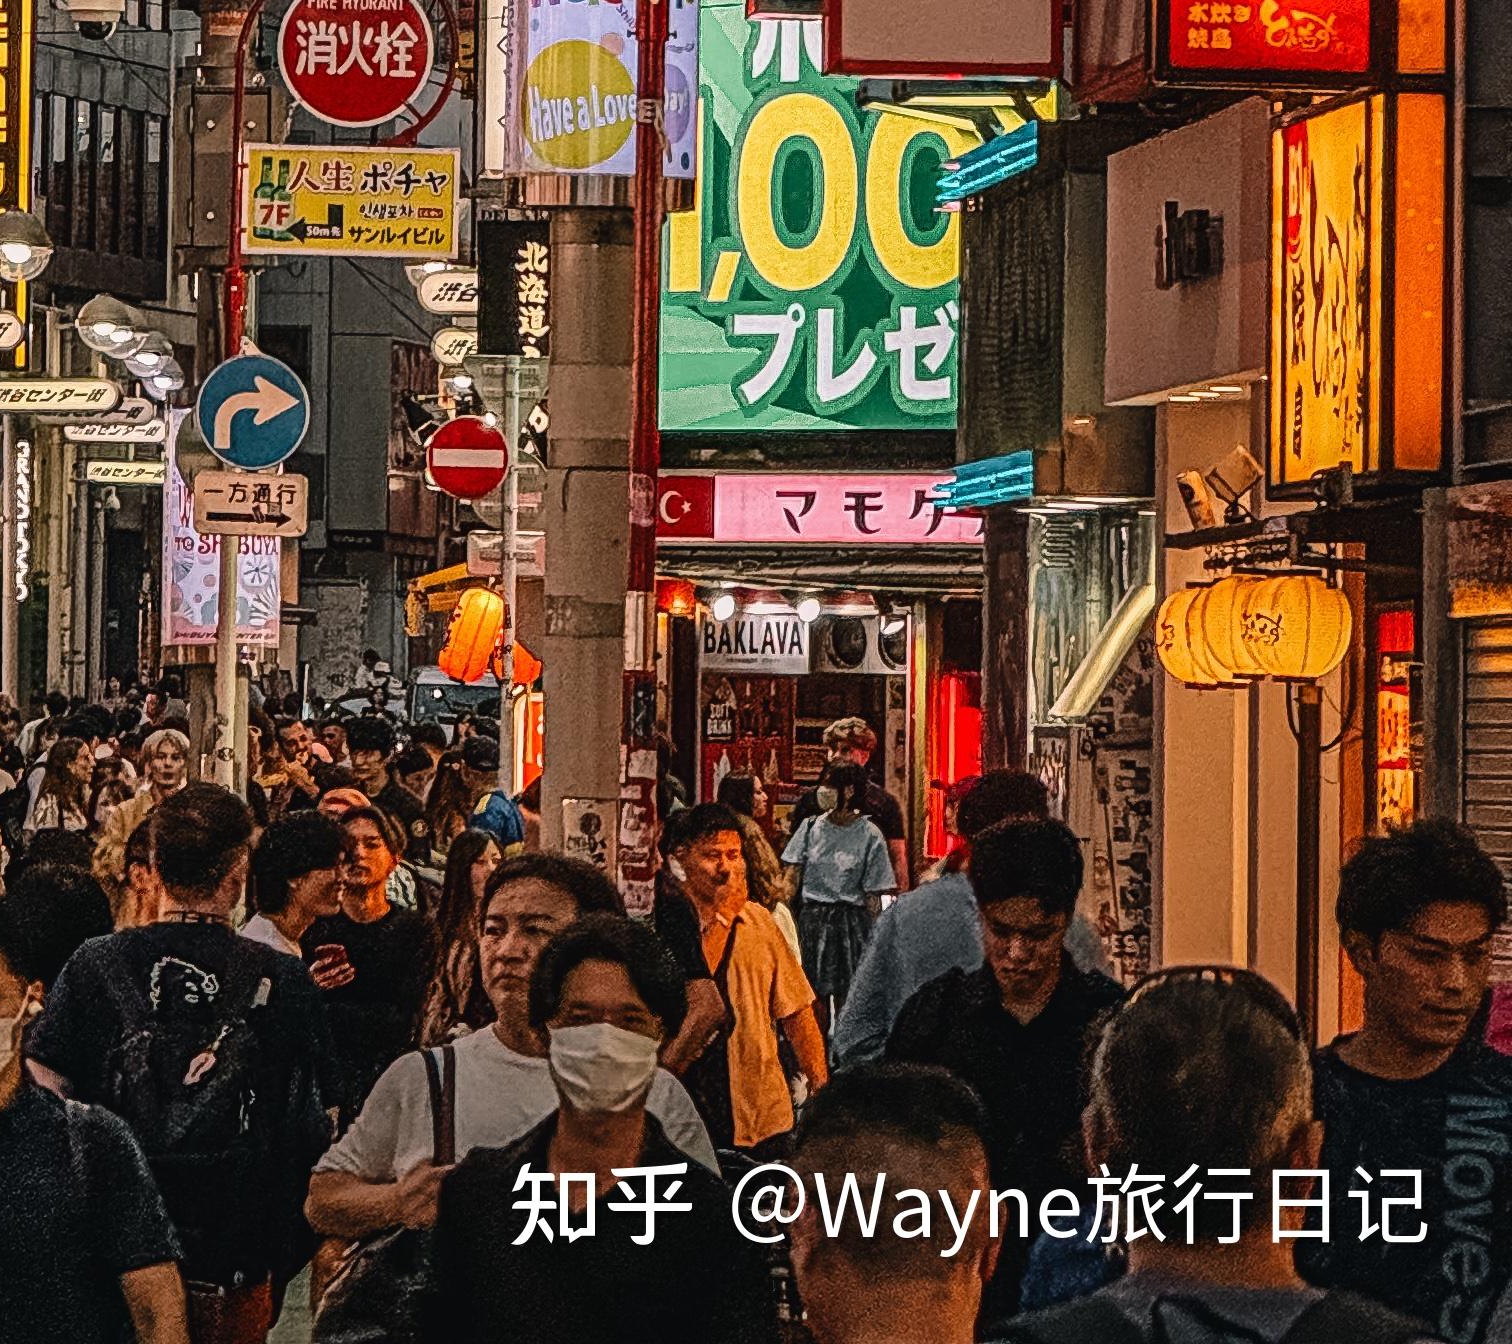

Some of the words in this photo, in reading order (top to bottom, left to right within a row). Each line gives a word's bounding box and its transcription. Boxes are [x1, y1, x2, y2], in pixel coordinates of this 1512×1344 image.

[294, 20, 419, 79] 消火栓
[528, 83, 573, 143] Have
[578, 96, 590, 130] a
[288, 160, 354, 194] 人生
[360, 161, 447, 196] ポチャ
[259, 204, 290, 227] 7F
[348, 226, 445, 246] サンルイビル
[731, 299, 959, 406] プレゼ
[203, 481, 298, 506] 一方通行
[174, 536, 195, 552] TO
[704, 620, 804, 655] BAKLAVA
